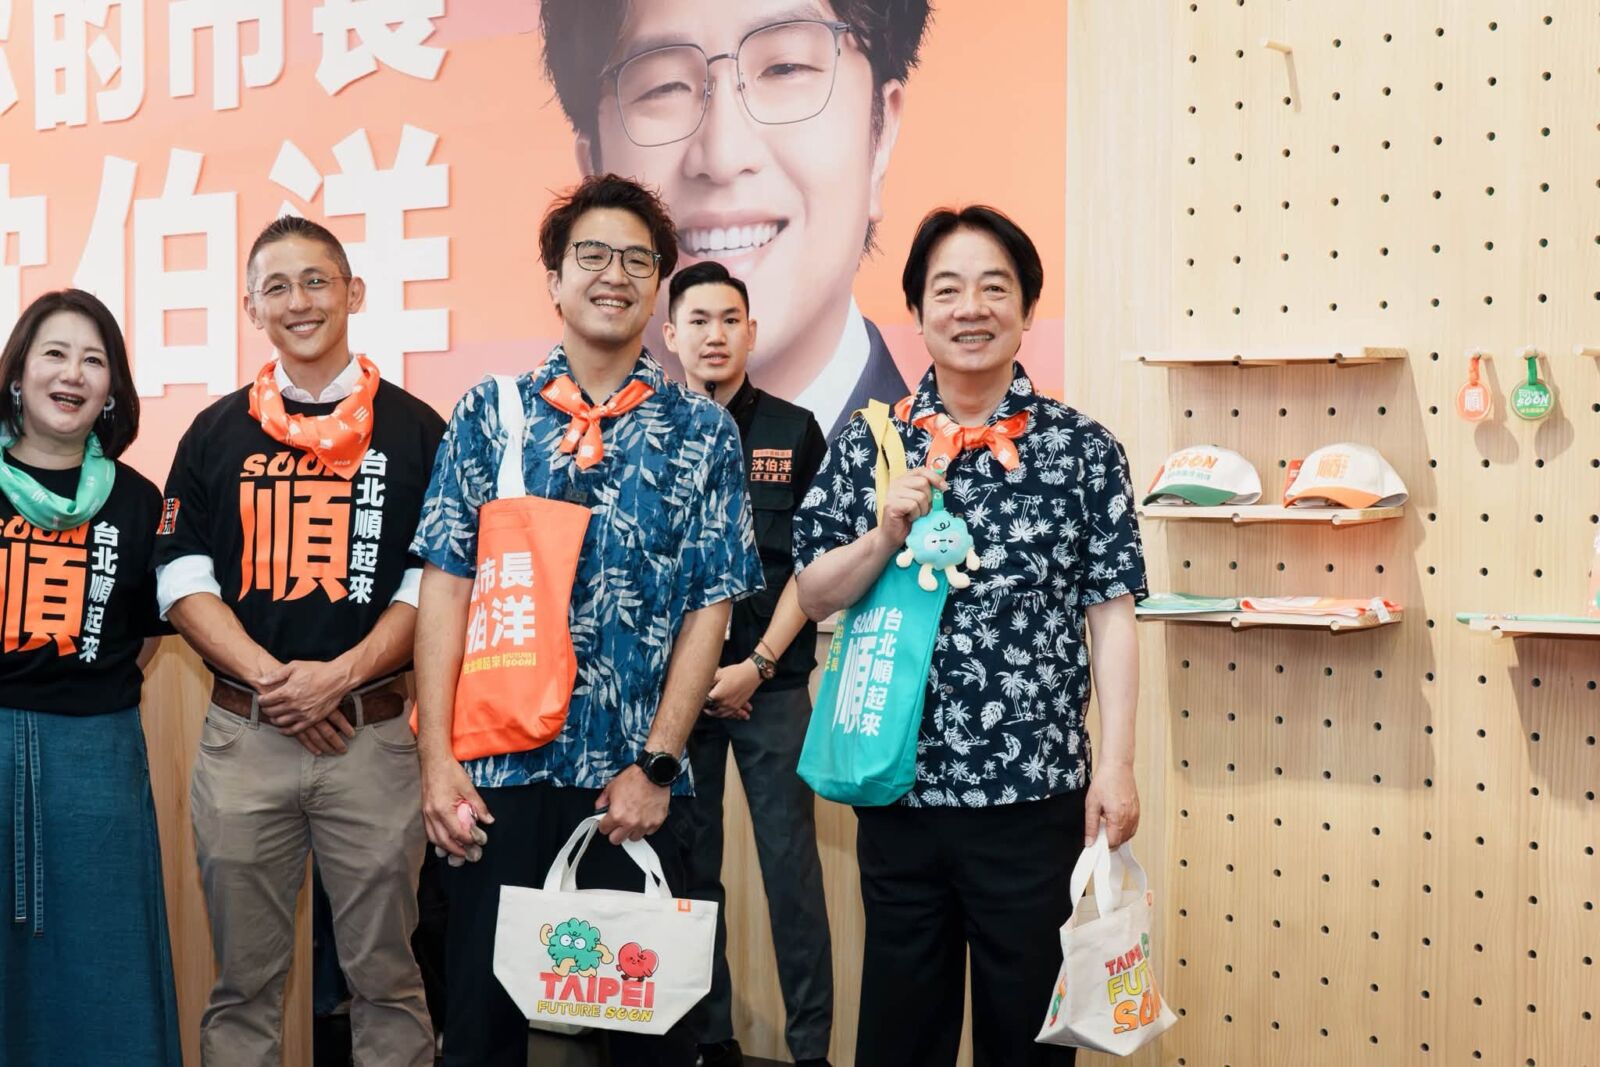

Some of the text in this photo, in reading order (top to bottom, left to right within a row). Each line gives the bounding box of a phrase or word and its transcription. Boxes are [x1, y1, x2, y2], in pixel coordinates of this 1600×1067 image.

[0, 0, 449, 130] 的市長
[240, 451, 334, 477] SOO
[751, 458, 792, 472] 沈伯洋
[0, 515, 90, 545] OON
[237, 480, 353, 604] 順
[349, 448, 388, 604] 台北順起來
[78, 520, 121, 663] 台北順起來
[851, 606, 886, 634] SOON
[860, 607, 903, 736] 台北順起來
[538, 971, 655, 1009] TAIPEI
[536, 1000, 654, 1022] FUTURE SOON
